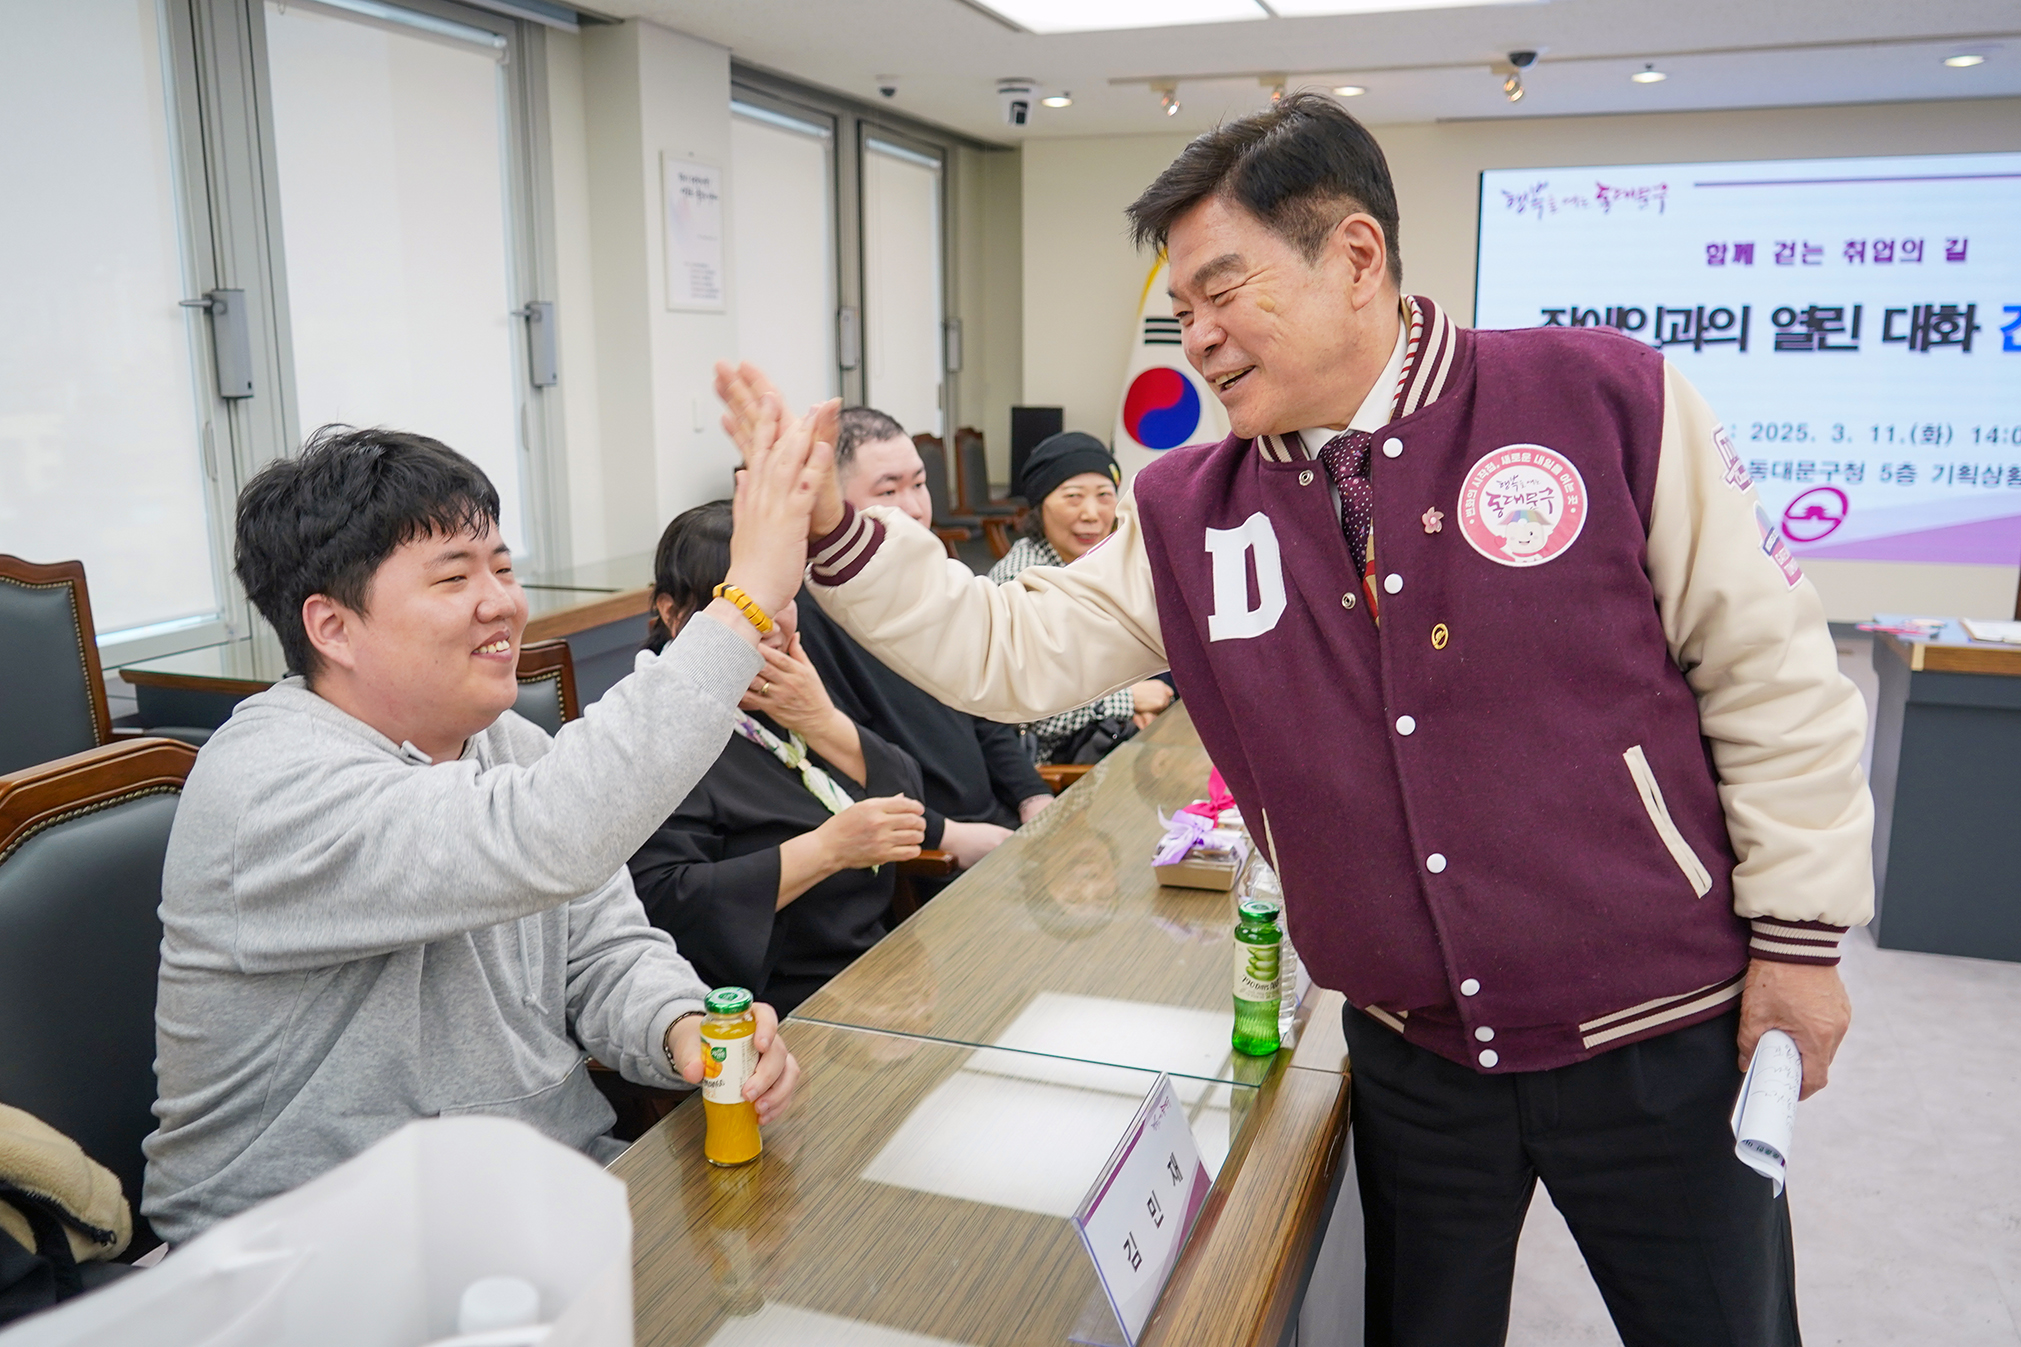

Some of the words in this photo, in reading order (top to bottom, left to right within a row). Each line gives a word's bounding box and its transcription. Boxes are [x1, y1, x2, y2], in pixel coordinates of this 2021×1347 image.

[1706, 242, 1755, 266] 함께
[1775, 241, 1824, 266] 걷는
[1844, 239, 1925, 264] 취업의
[1945, 237, 1969, 263] 길
[1771, 304, 1862, 353] 열린
[1883, 304, 1981, 353] 대화
[1751, 422, 1817, 443] 2025.
[1832, 423, 1853, 443] 3.
[1872, 422, 1953, 447] 11.(화)
[1501, 452, 1532, 465] 새로운
[1533, 454, 1564, 476] 내일을
[1560, 473, 1575, 493] 여는
[1750, 459, 1865, 484] 동대문구청
[1880, 461, 1918, 486] 5층
[1486, 487, 1555, 518] 동대문구
[1567, 495, 1579, 505] 곳
[1205, 511, 1288, 642] D
[1122, 1231, 1143, 1273] 김
[1146, 1190, 1165, 1229] 민
[1166, 1152, 1184, 1187] 재
